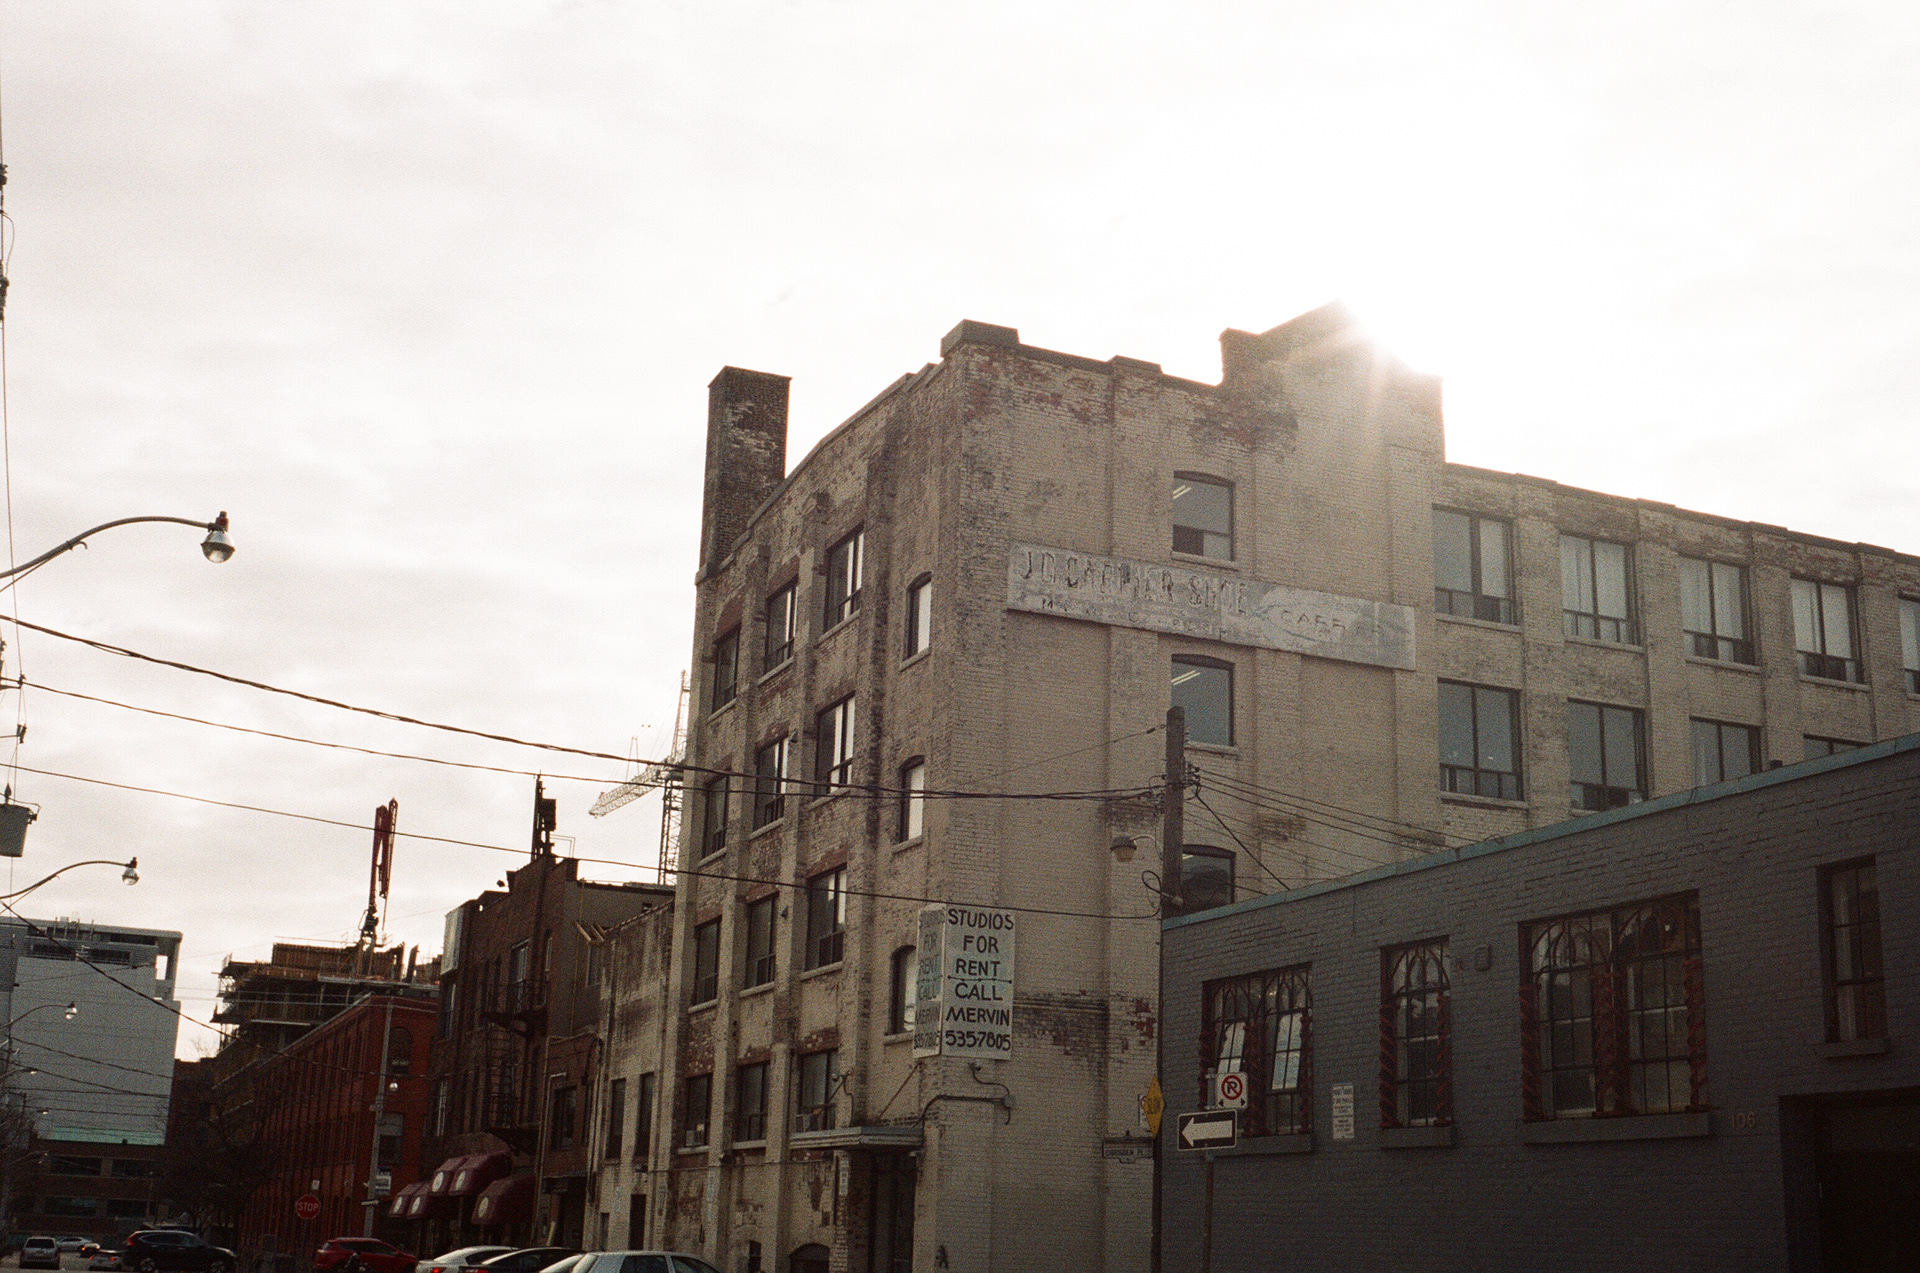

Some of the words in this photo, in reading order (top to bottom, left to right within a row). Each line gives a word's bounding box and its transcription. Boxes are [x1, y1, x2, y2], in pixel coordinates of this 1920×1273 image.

[948, 908, 1014, 931] STUDIOS
[963, 935, 999, 954] FOR
[955, 958, 1000, 976] RENT
[955, 982, 1003, 1000] CALL
[946, 1006, 1010, 1026] MERVIN
[298, 1201, 319, 1212] STOP
